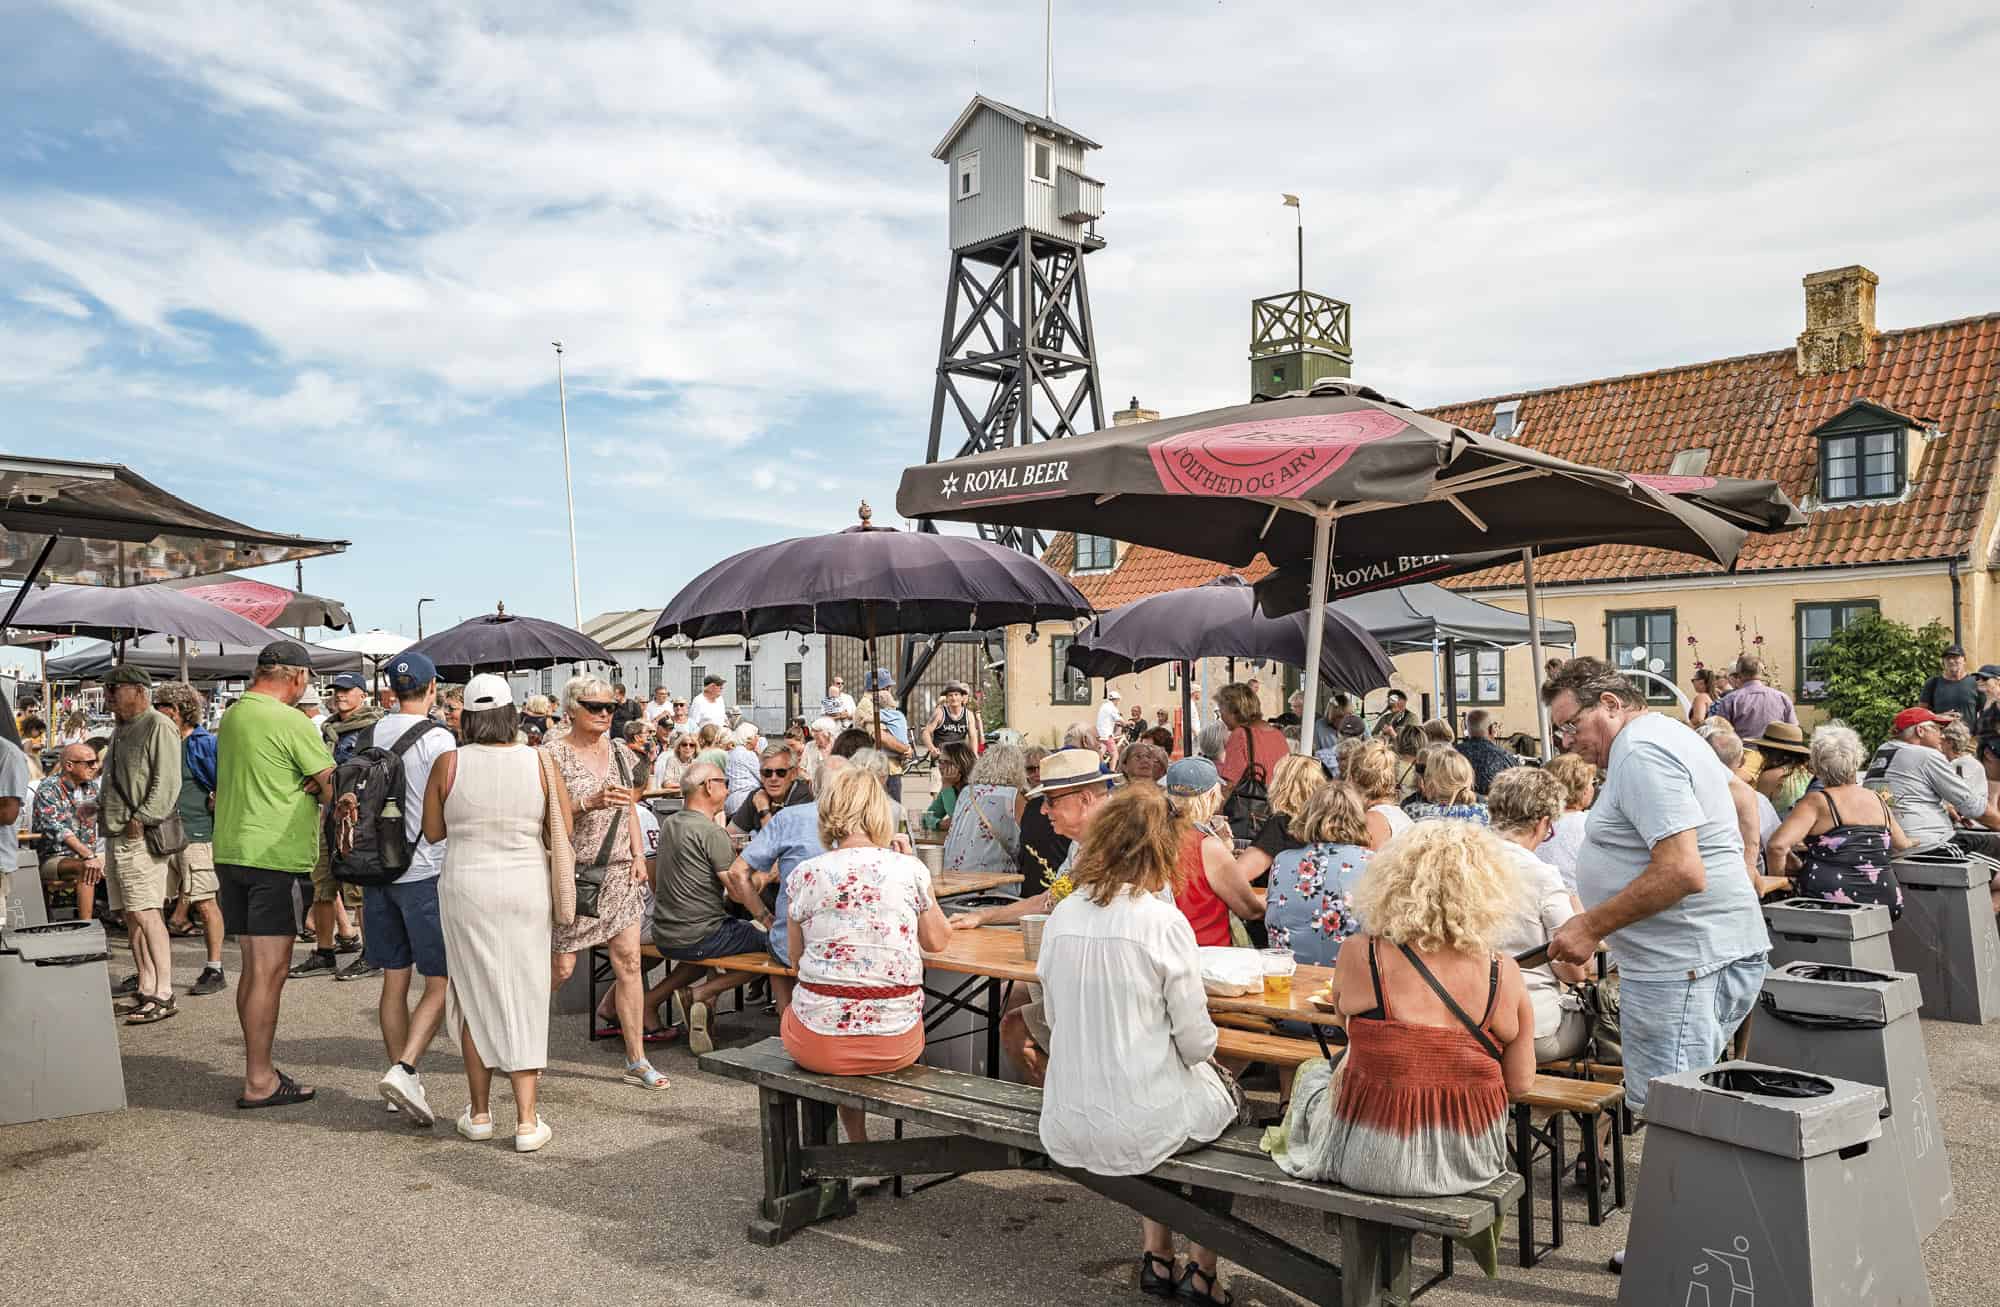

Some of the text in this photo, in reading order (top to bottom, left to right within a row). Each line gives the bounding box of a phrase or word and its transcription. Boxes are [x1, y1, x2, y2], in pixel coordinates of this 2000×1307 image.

[963, 460, 1069, 493] ROYAL BEER
[1172, 445, 1317, 494] TOLTHED OG ARV
[1334, 562, 1394, 591] ROYAL
